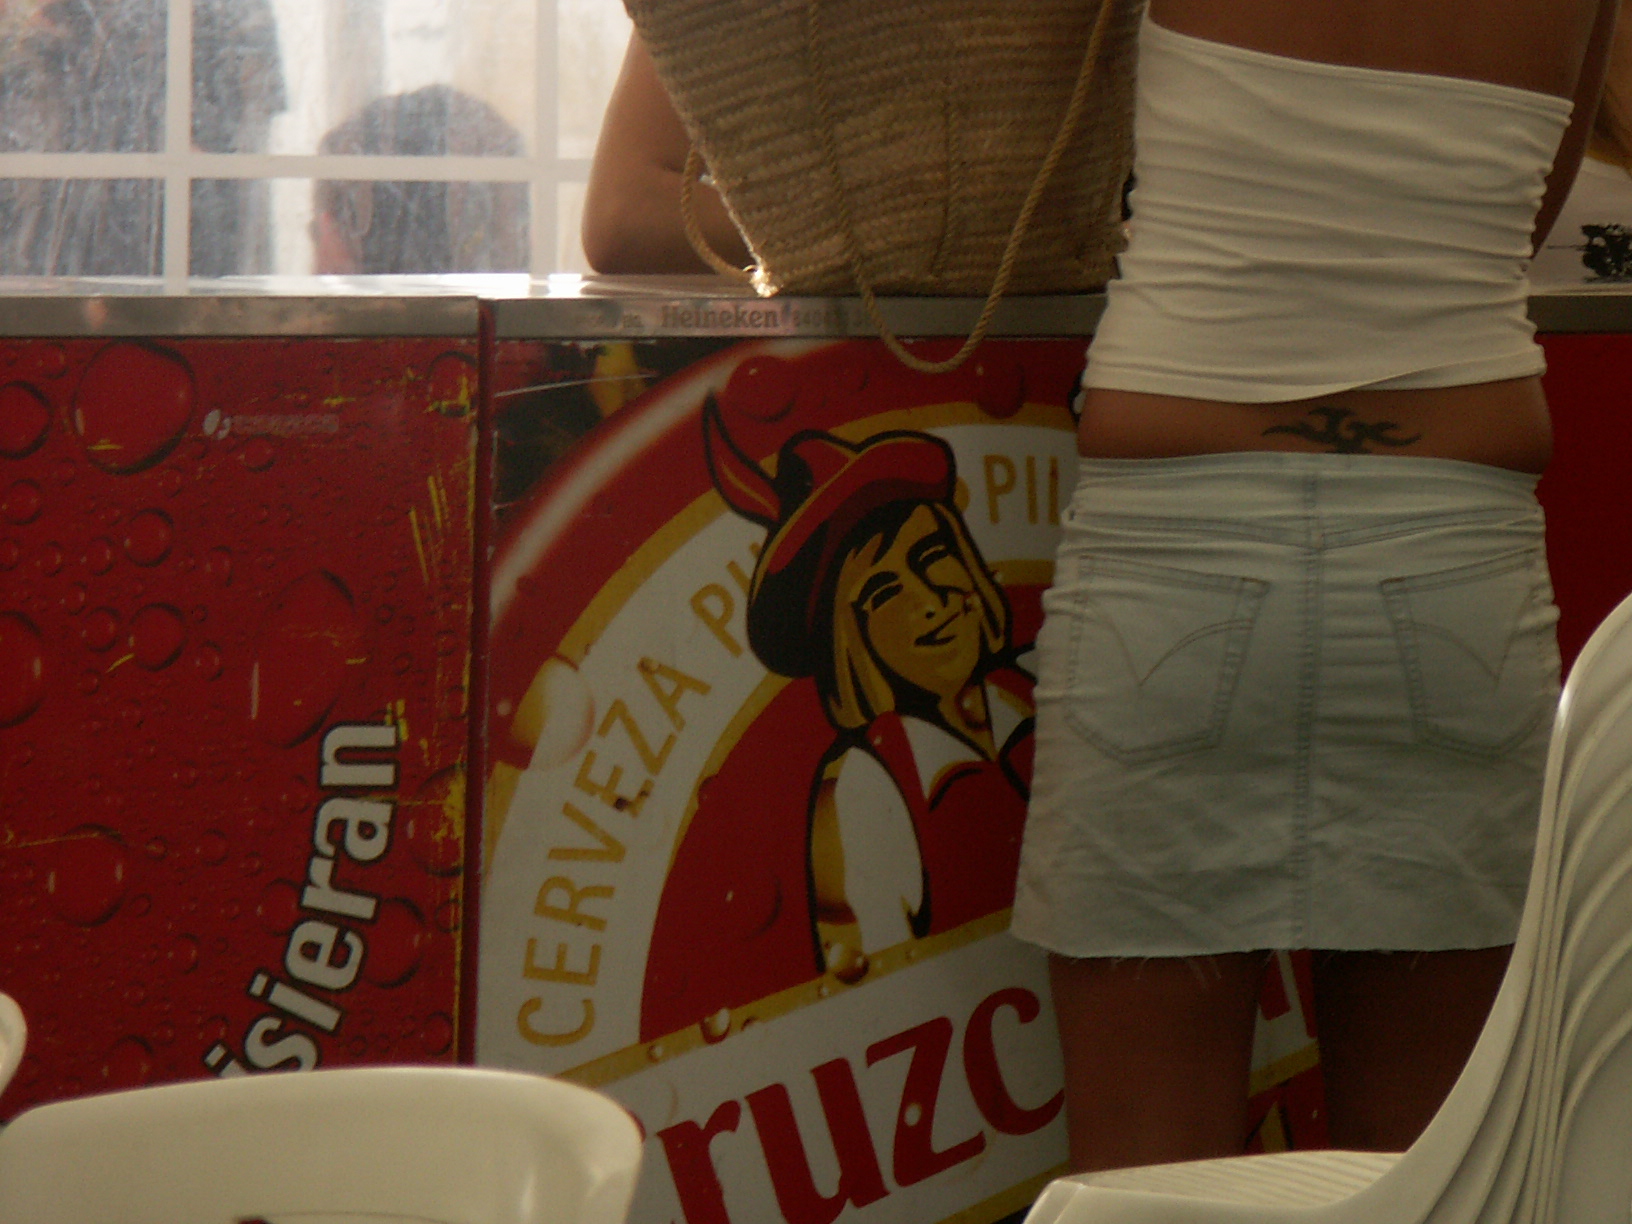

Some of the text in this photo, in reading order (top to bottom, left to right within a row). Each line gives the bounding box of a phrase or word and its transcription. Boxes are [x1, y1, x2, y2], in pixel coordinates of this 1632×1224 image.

[661, 305, 779, 327] Heineken
[517, 657, 711, 1047] CERVEZA
[655, 986, 1066, 1224] ruzc
